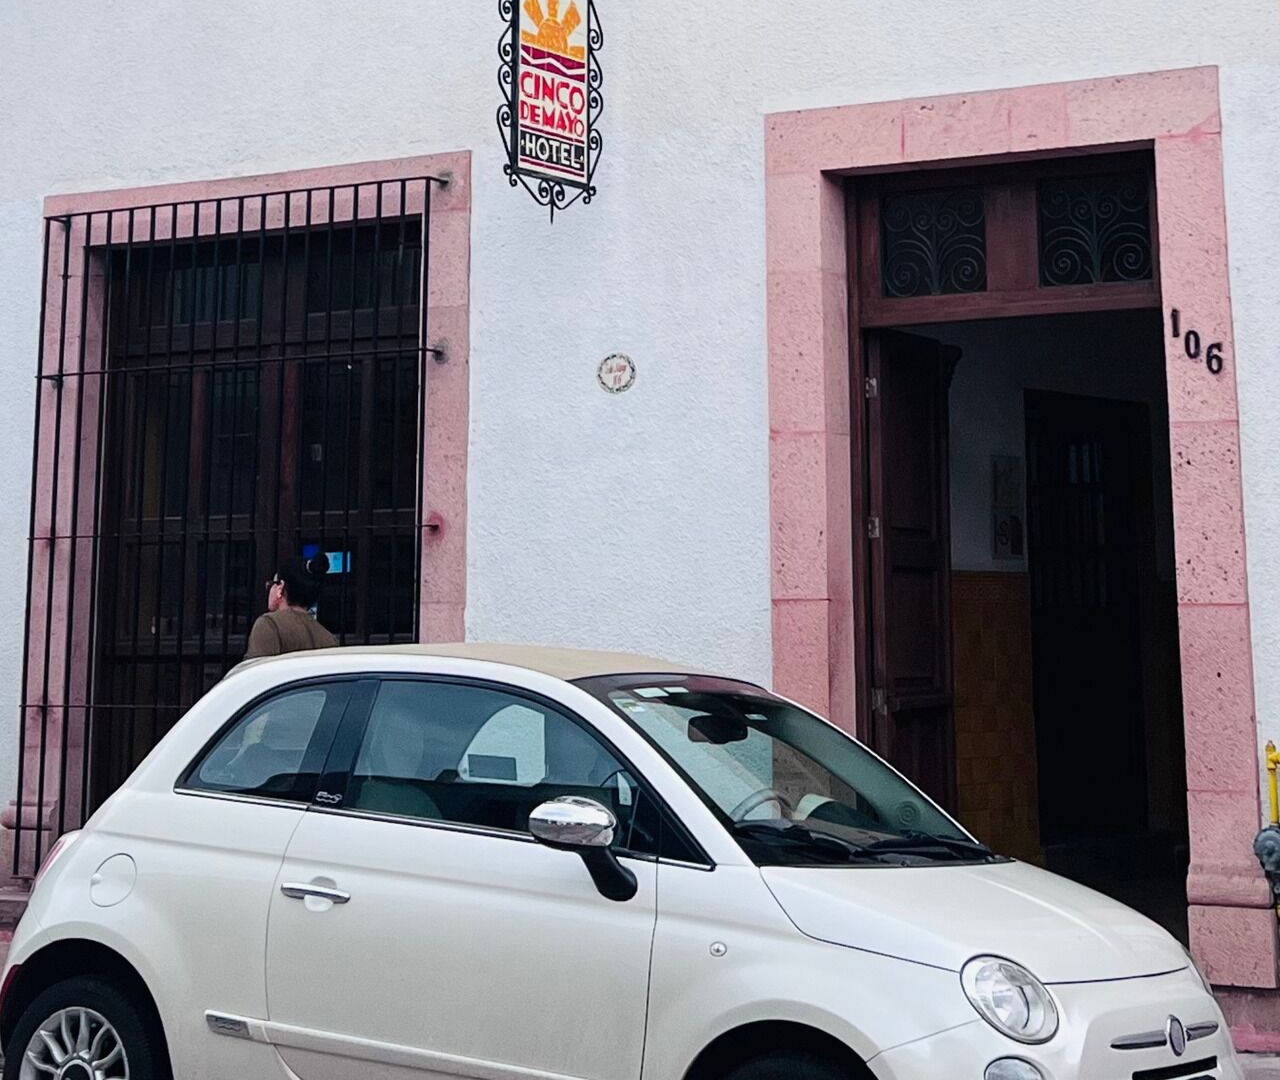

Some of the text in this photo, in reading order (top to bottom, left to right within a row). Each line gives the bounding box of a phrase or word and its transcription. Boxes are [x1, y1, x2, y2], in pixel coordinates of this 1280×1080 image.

[520, 71, 585, 116] CINCO
[520, 99, 585, 138] DE MAYO
[525, 133, 581, 168] HOTEL
[1171, 308, 1223, 375] 106
